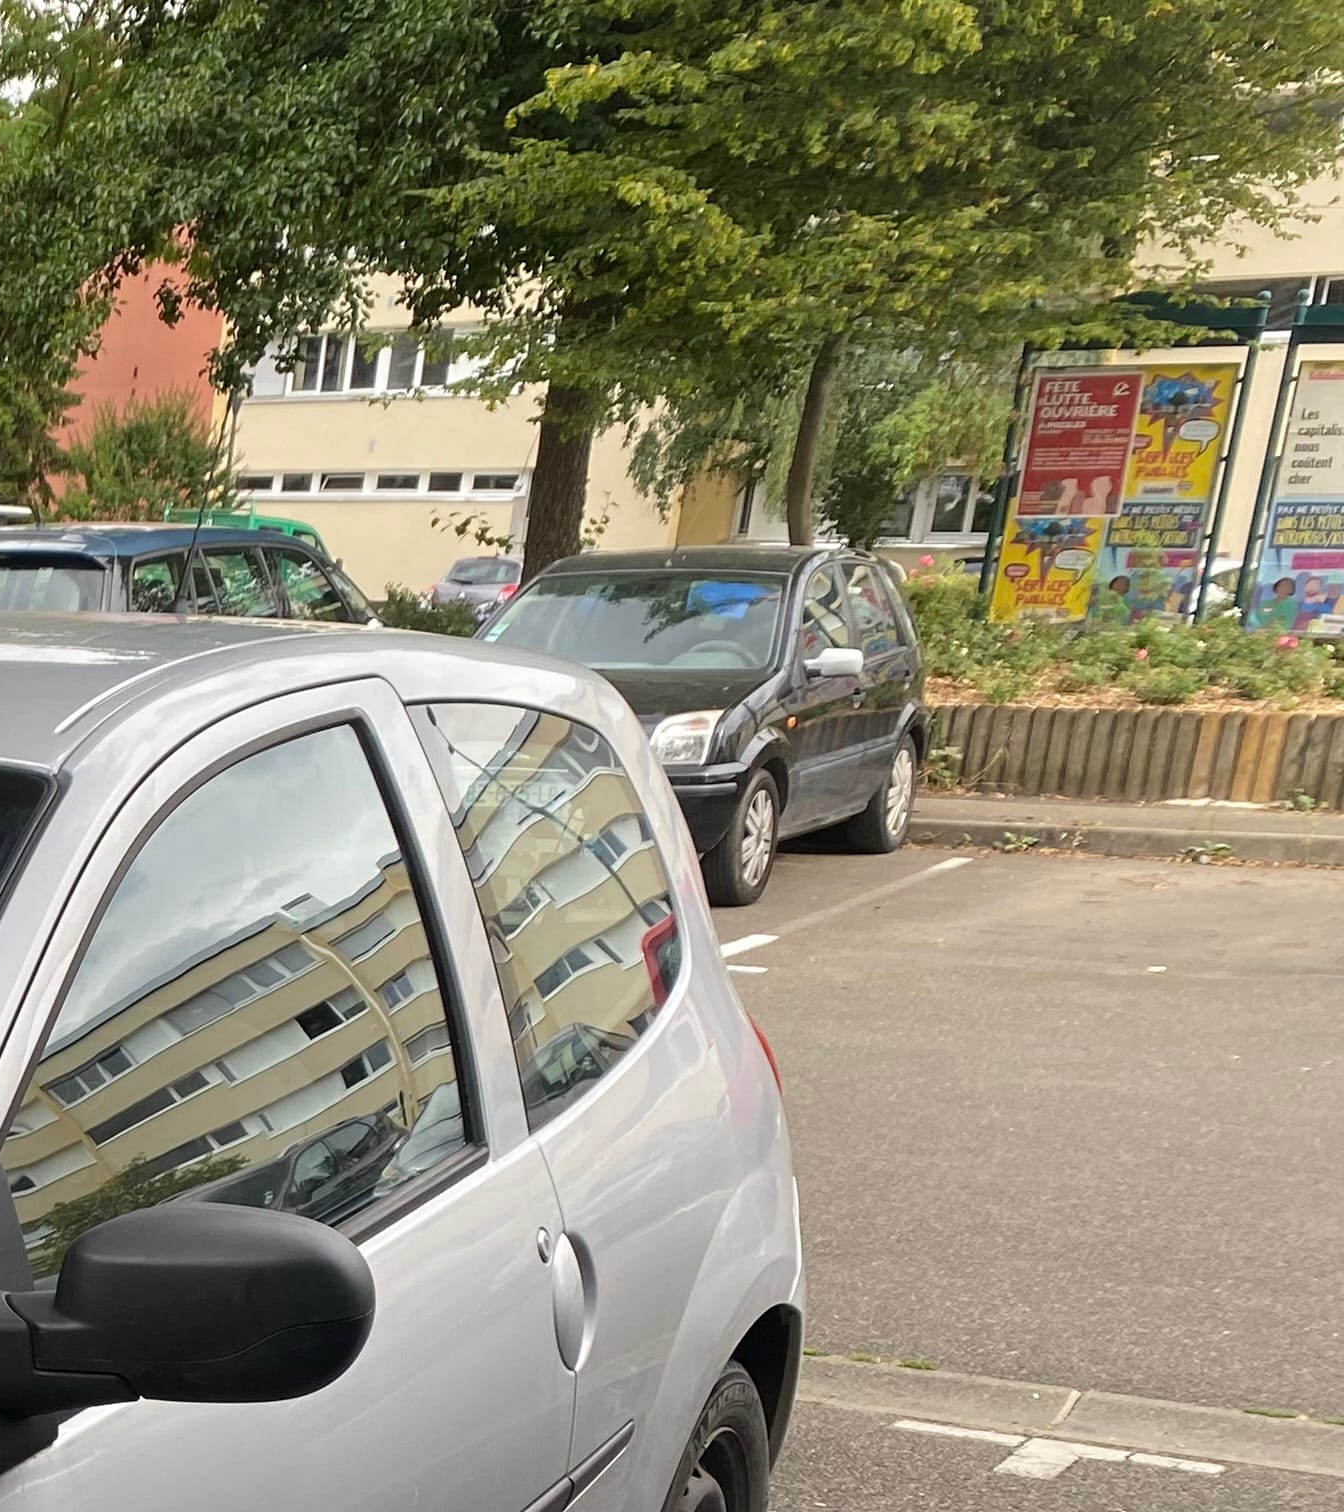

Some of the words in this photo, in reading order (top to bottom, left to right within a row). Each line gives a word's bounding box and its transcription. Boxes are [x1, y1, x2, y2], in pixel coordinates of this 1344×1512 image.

[1044, 379, 1082, 393] FÊTE
[1043, 392, 1093, 405] LUTTE
[1301, 407, 1320, 420] Les
[1297, 423, 1344, 438] capitalis
[1294, 443, 1320, 453] nous
[1291, 455, 1333, 469] coûtent
[1287, 473, 1313, 484] cher
